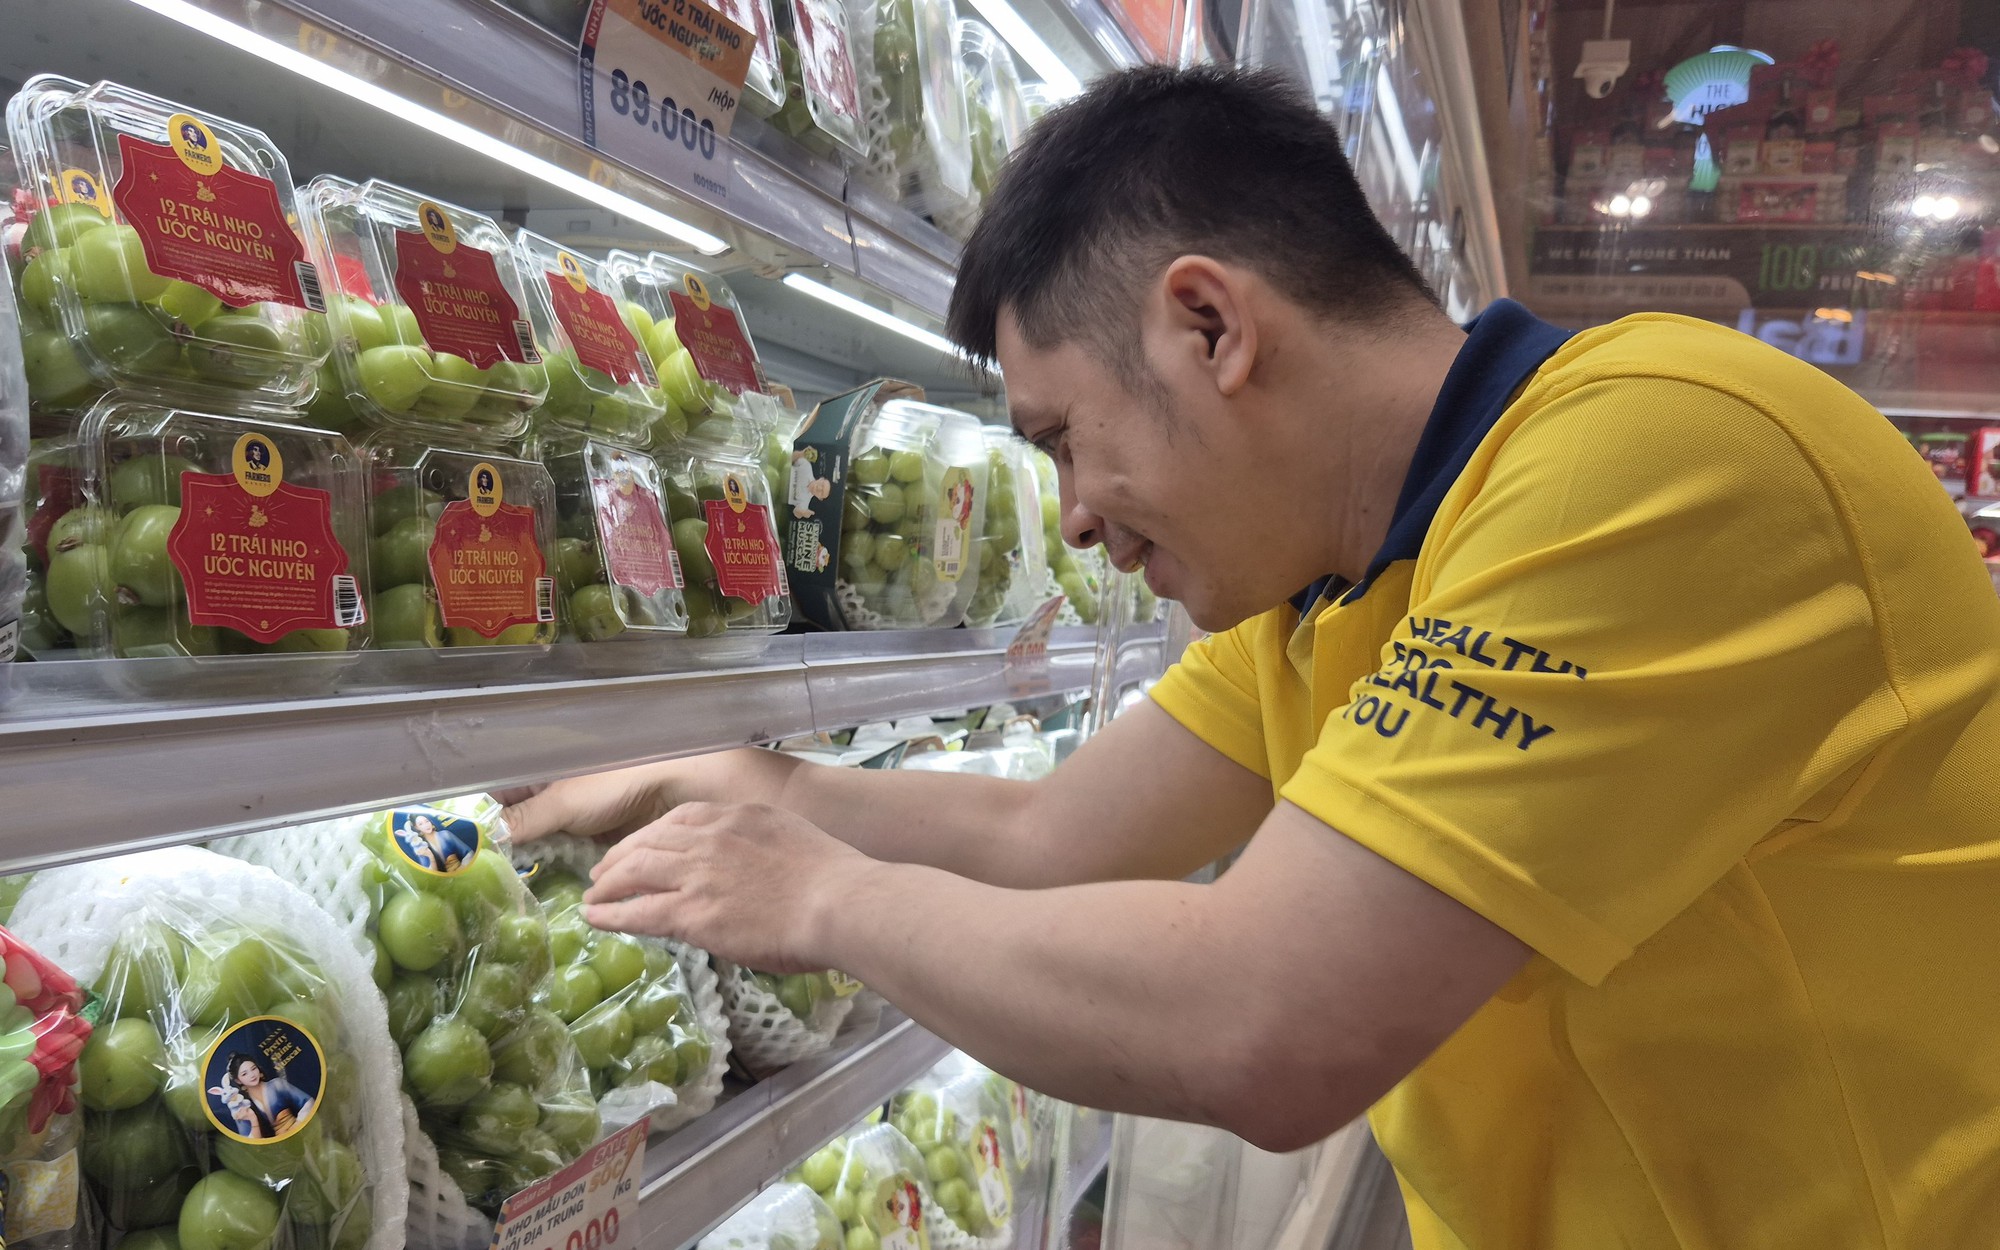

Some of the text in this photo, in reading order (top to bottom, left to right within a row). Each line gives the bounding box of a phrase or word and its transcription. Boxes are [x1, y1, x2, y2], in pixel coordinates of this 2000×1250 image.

[688, 3, 713, 37] TRÁI
[715, 24, 741, 50] NHO
[583, 57, 594, 142] IMPORTED
[706, 86, 736, 113] /HỘP
[1706, 84, 1733, 99] THE
[610, 68, 717, 162] 89.000
[159, 197, 264, 240] 12 TRÁI NHO
[156, 214, 276, 263] ƯỚC NGUYỆN
[1685, 249, 1732, 261] THAN
[435, 282, 461, 301] TRÁI
[463, 287, 490, 305] NHO
[422, 294, 502, 326] ƯỚC NGUYỆN
[211, 533, 308, 559] 12 TRÁI NHO
[453, 548, 519, 566] 12 TRÁI NHO
[749, 539, 765, 551] NHO
[796, 523, 804, 568] MUSCAT
[803, 524, 813, 570] SHINE
[204, 554, 316, 583] ƯỚC NGUYỆN
[450, 567, 524, 587] ƯỚC NGUYỆN
[1409, 615, 1587, 681] HEALTH
[262, 1033, 288, 1056] Pretty
[270, 1041, 294, 1064] Shine
[612, 1178, 632, 1201] /KG
[505, 1213, 533, 1241] NHO
[547, 1199, 585, 1232] TRUNG
